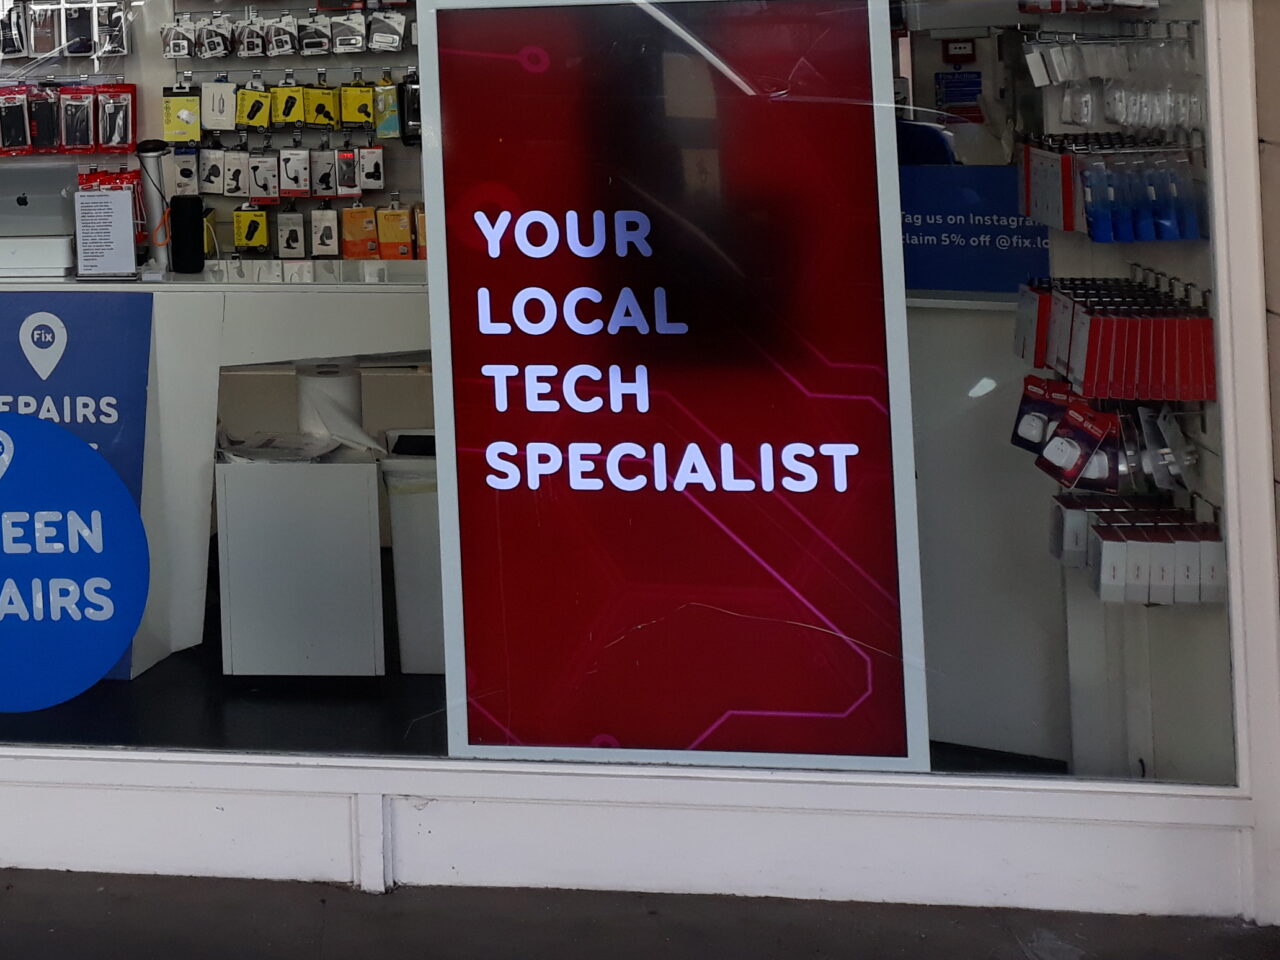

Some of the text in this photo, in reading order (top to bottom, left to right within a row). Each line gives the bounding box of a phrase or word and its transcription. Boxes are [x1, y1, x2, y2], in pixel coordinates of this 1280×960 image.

[473, 209, 653, 259] YOUR
[926, 214, 943, 225] us
[947, 215, 965, 225] on
[941, 233, 966, 246] 5%
[969, 233, 991, 246] off
[33, 329, 54, 343] Fix
[476, 286, 689, 336] LOCAL
[481, 364, 650, 414] TECH
[485, 441, 860, 493] SPECIALIST
